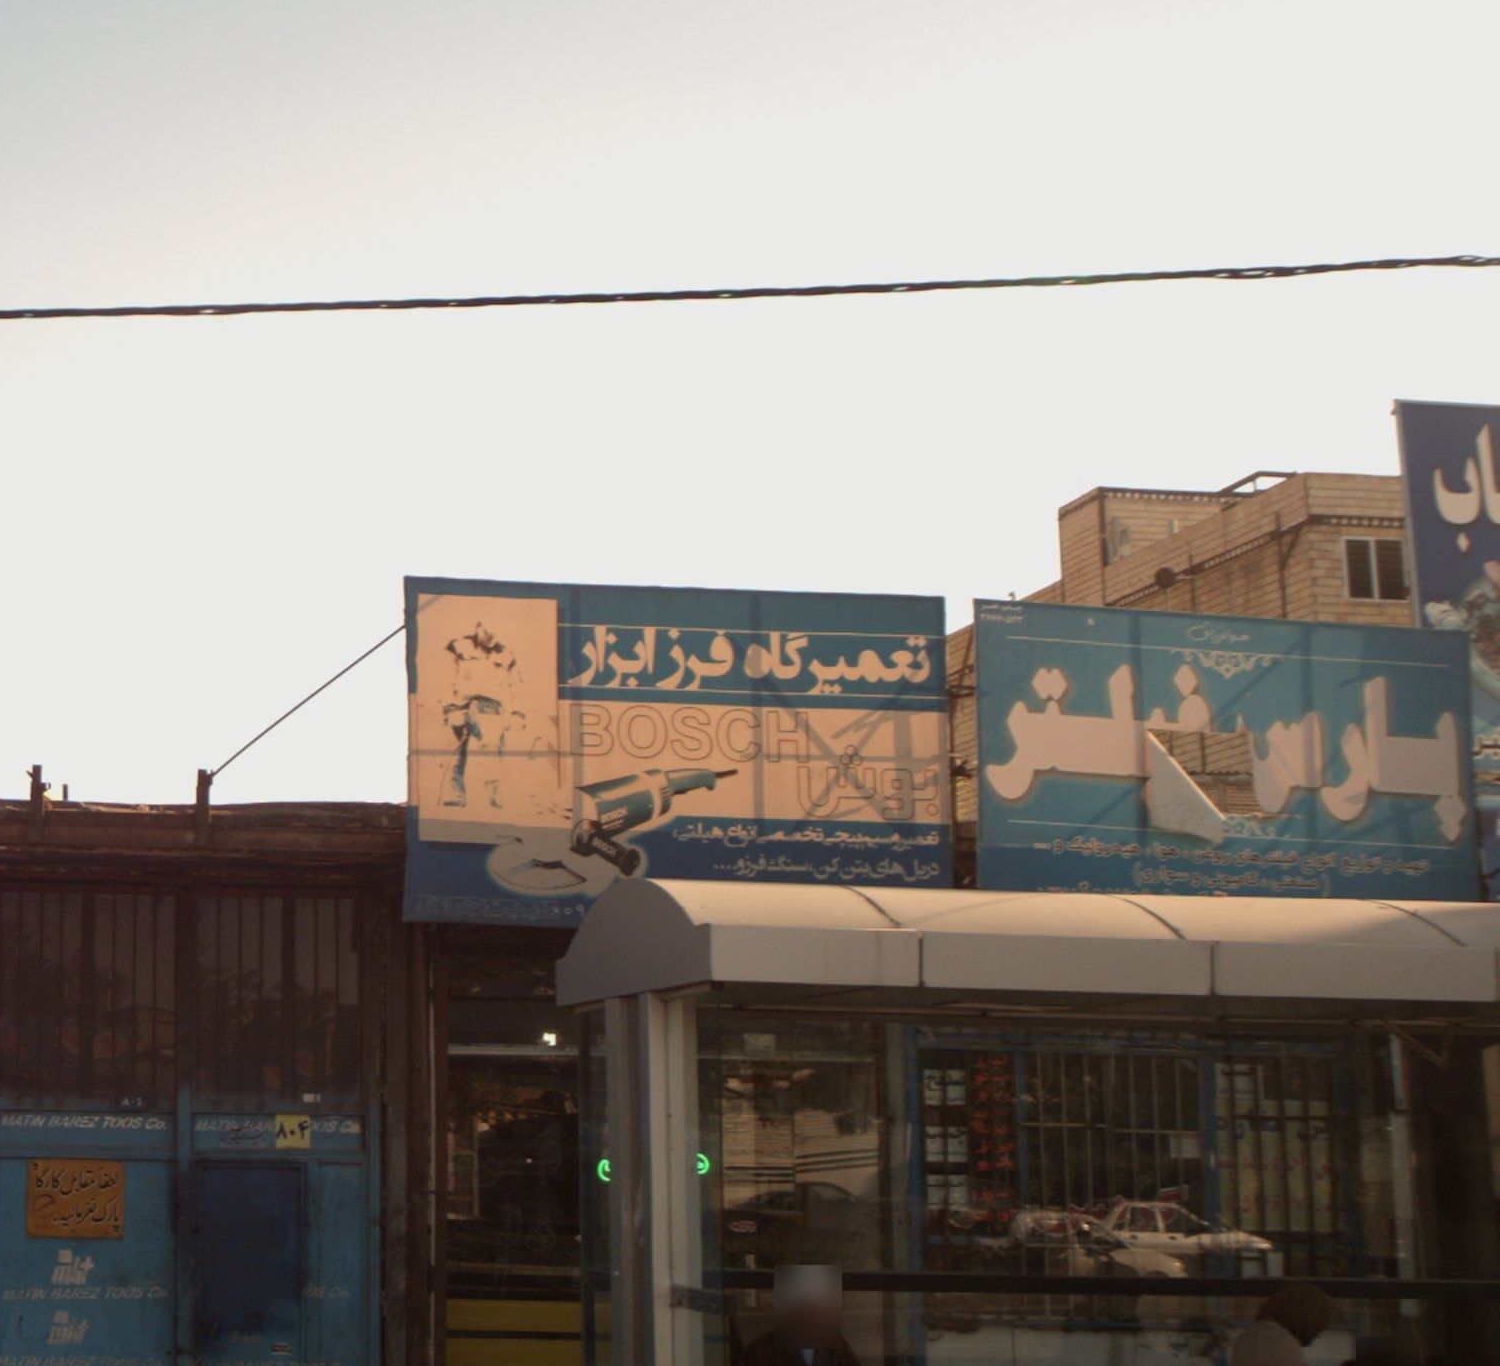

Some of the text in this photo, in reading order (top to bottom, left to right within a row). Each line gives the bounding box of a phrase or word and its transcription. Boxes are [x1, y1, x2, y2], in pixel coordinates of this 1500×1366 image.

[744, 631, 931, 695] تعمیرگاه
[569, 703, 810, 764] BOSCH
[796, 744, 939, 821] بوش
[0, 1115, 47, 1128] MATIN
[47, 1115, 100, 1129] BAREZ
[102, 1116, 144, 1130] TOOS
